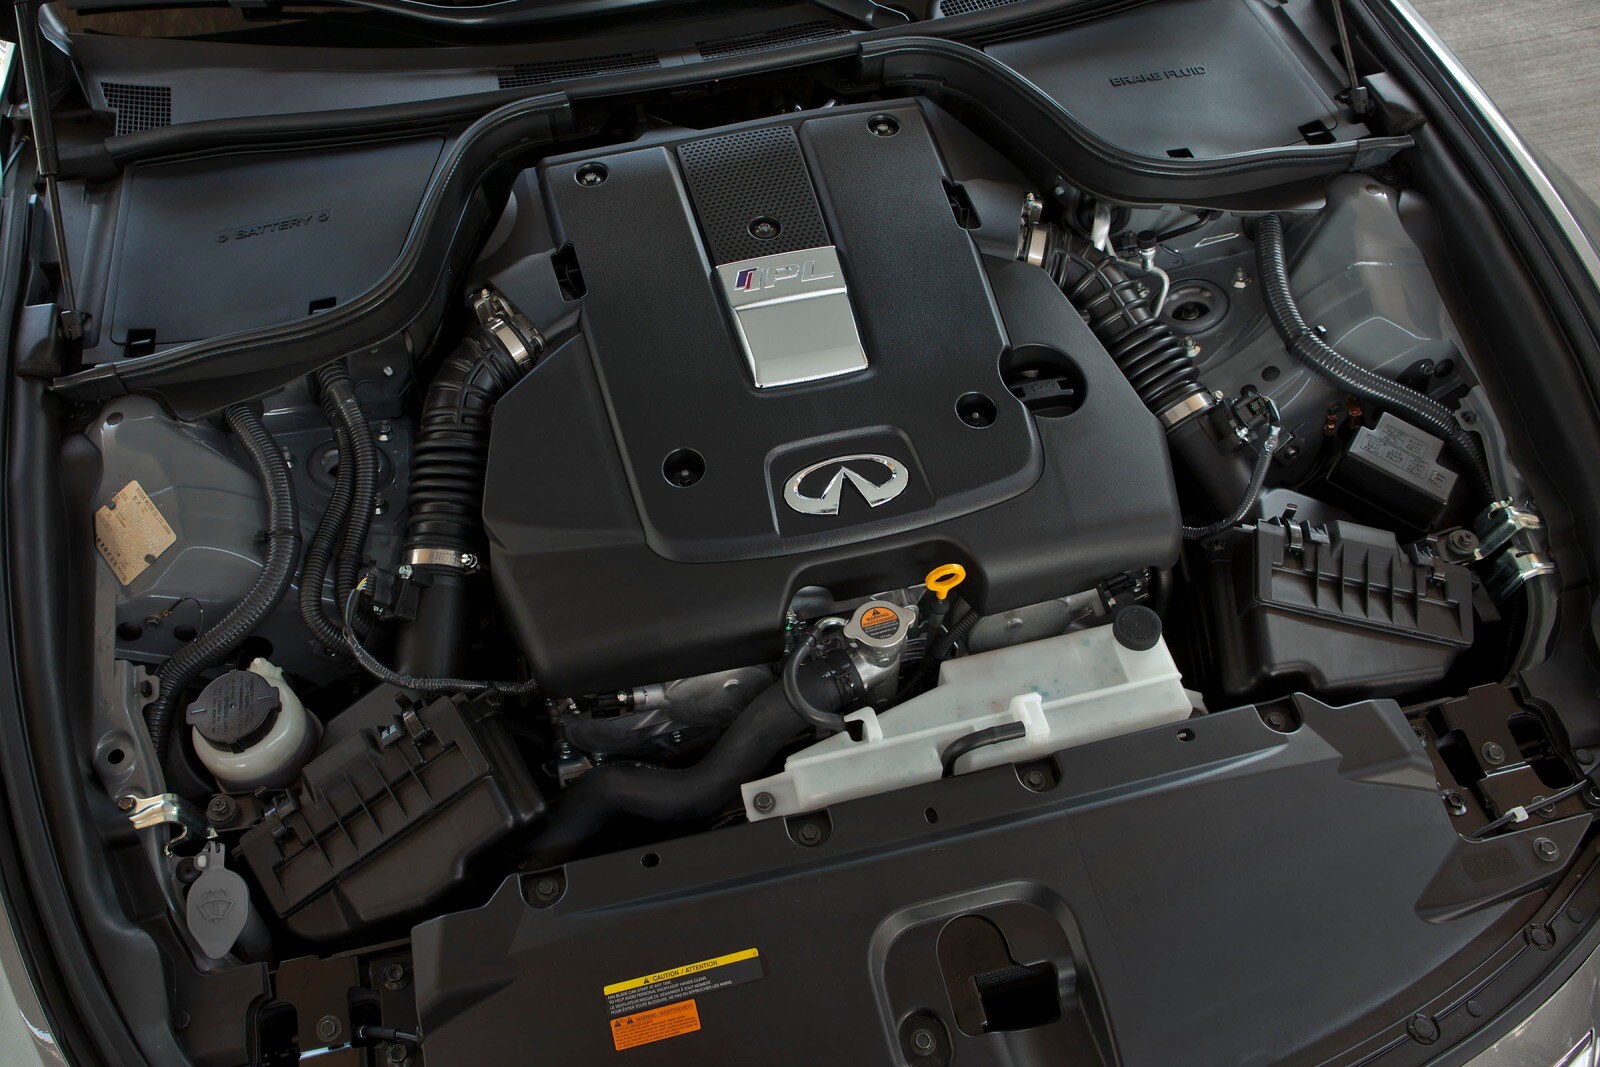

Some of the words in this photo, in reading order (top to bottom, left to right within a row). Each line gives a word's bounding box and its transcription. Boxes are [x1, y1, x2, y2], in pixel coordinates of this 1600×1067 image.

[1110, 72, 1162, 87] BRAKE
[1164, 66, 1206, 79] FLUID
[236, 214, 312, 240] BATTERY
[734, 259, 835, 292] IPL
[653, 970, 679, 981] CAUTION
[685, 960, 718, 973] ATTENTION
[636, 1013, 657, 1022] WARNING
